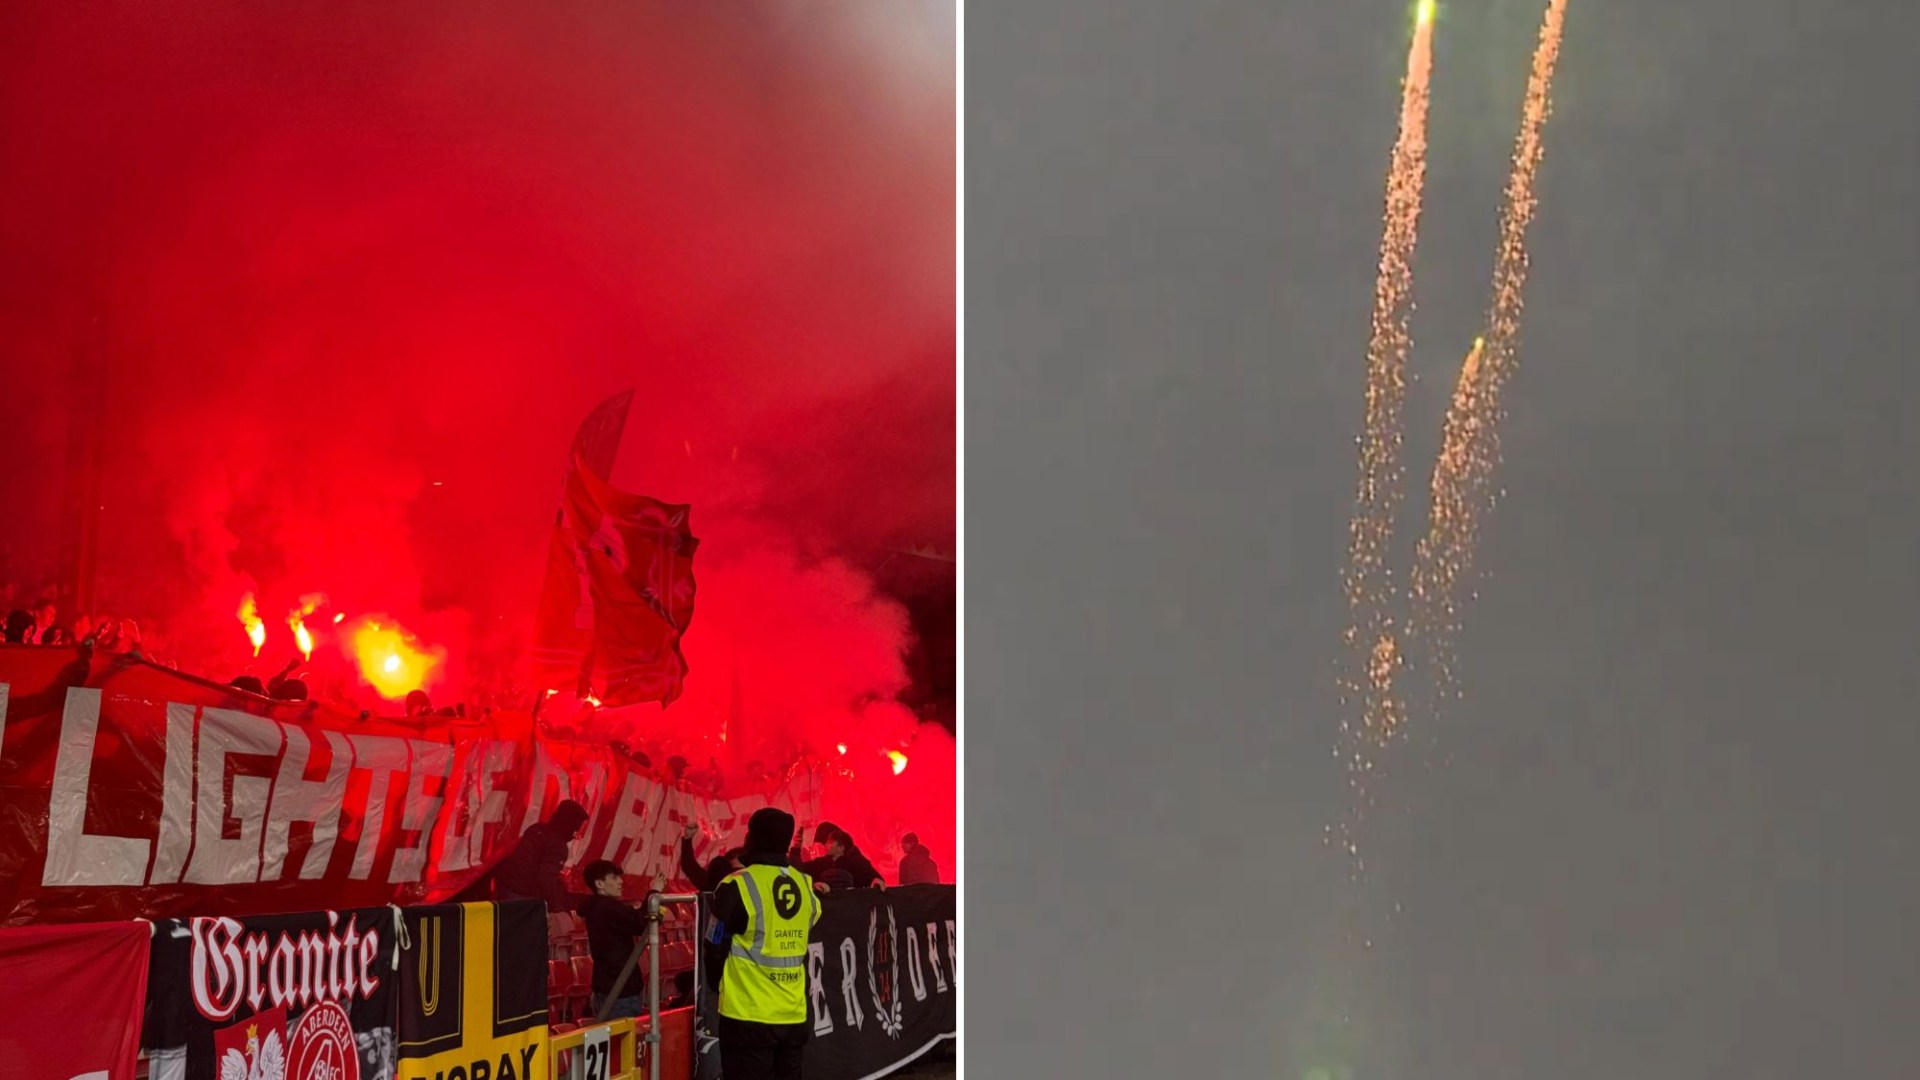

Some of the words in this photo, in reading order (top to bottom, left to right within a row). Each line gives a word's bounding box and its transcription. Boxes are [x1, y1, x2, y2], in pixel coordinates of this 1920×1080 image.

[42, 686, 454, 886] LIGHTS
[775, 929, 803, 938] GRANITE
[780, 941, 796, 950] ELITE
[190, 910, 379, 1022] Granite
[302, 1009, 350, 1052] ABERDEEN
[637, 1041, 647, 1059] 27
[411, 1042, 539, 1080] RAY
[586, 1040, 609, 1080] 27
